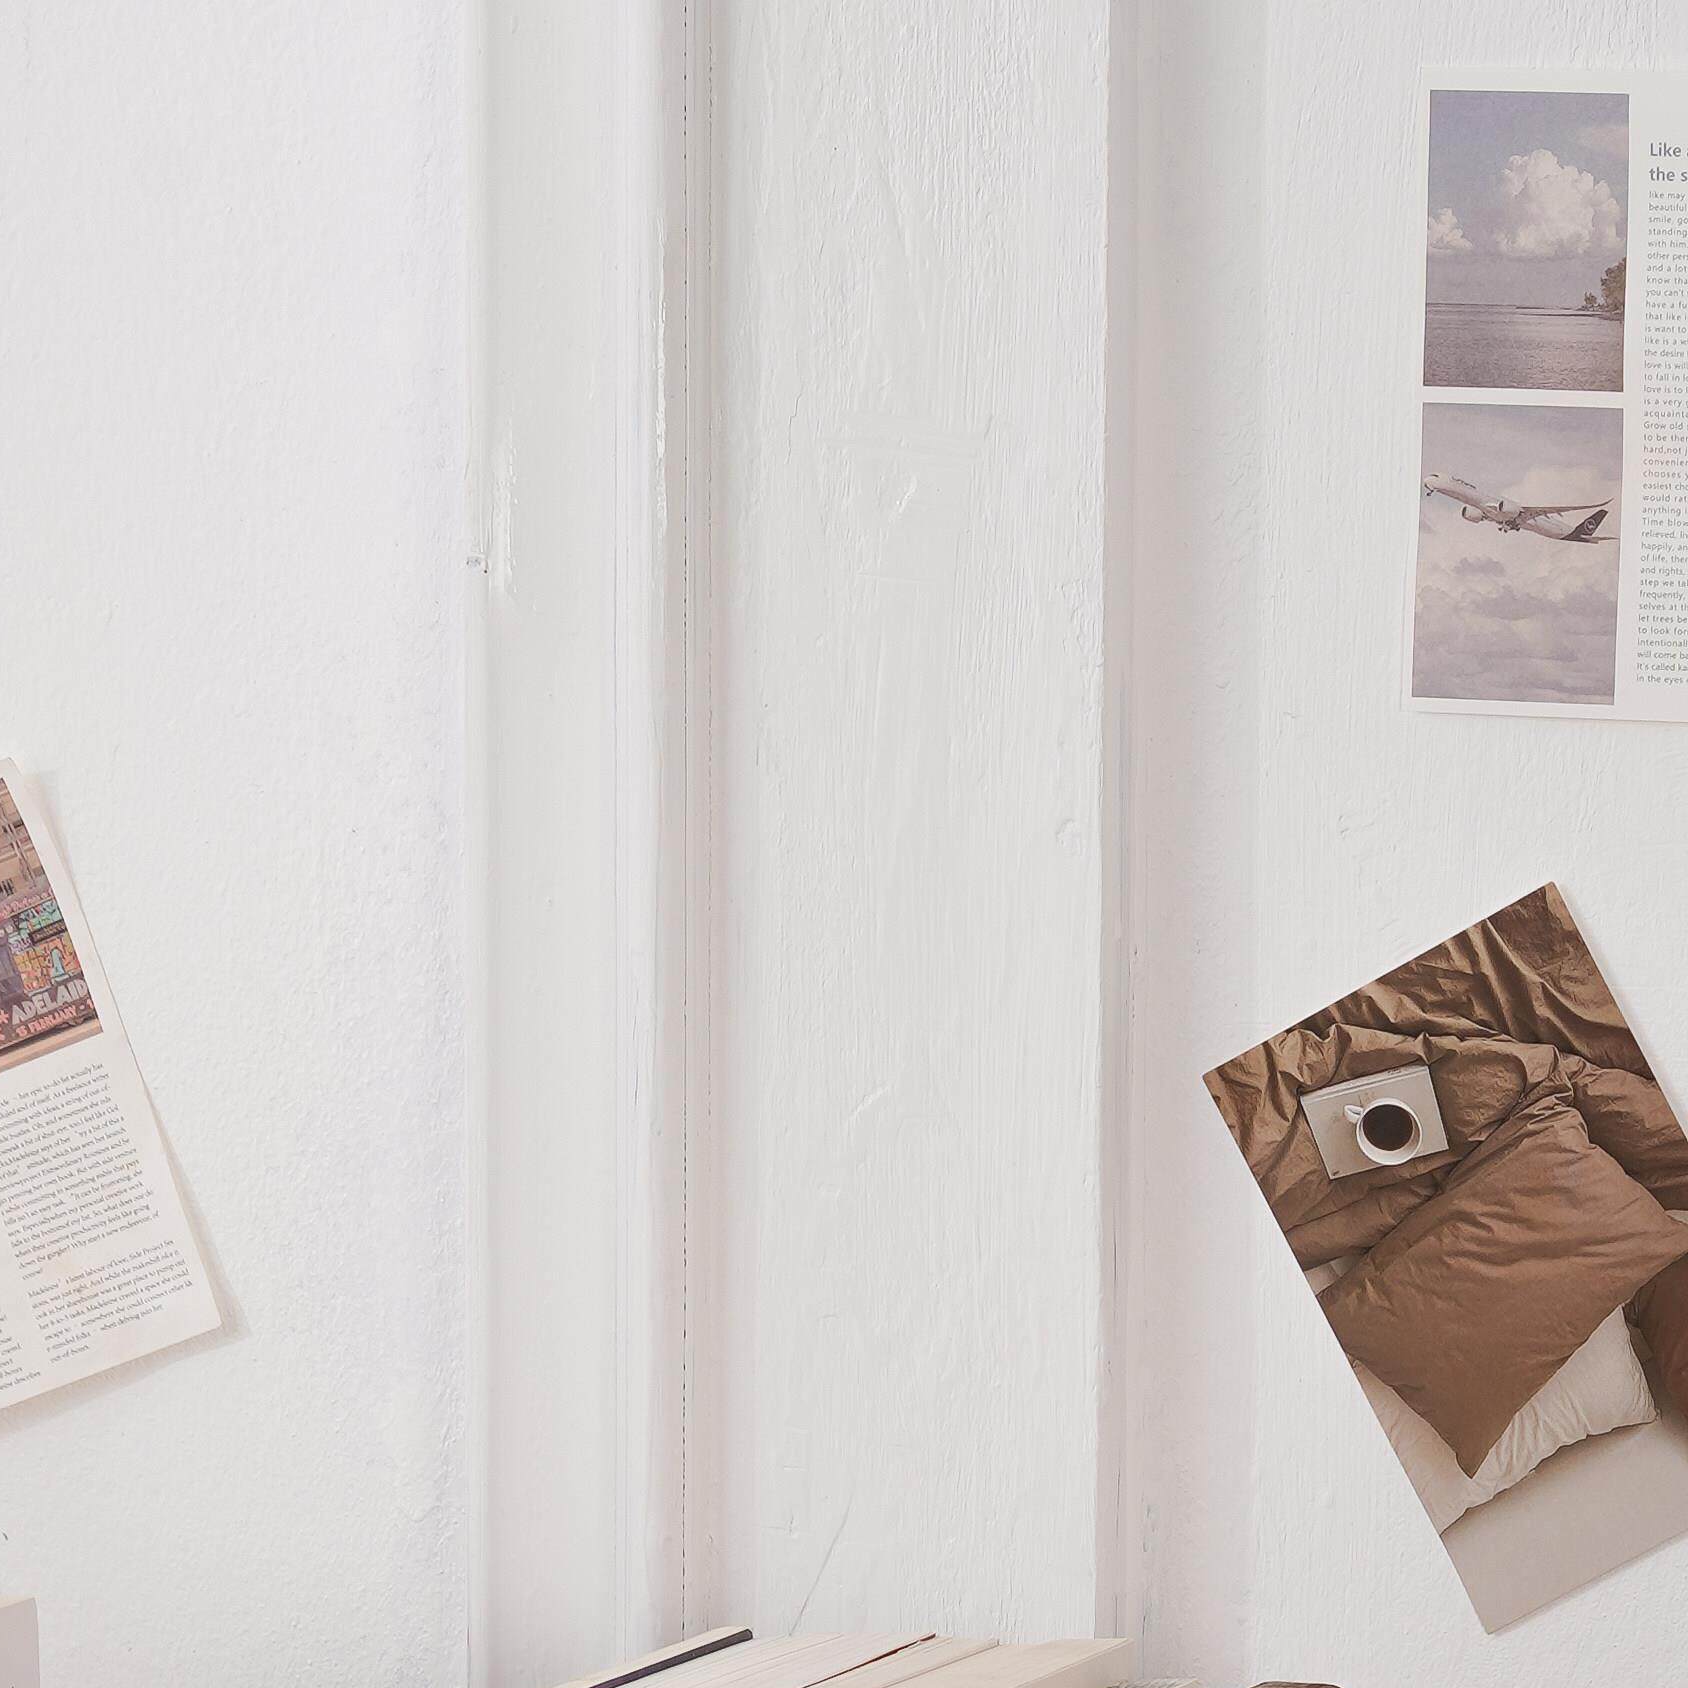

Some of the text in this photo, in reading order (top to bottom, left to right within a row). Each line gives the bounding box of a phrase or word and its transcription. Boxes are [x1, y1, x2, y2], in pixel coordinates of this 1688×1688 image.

[1649, 142, 1681, 157] Like
[1649, 168, 1675, 182] the
[1649, 191, 1685, 203] like may
[1648, 203, 1687, 212] beautiful
[1648, 227, 1688, 238] standing
[1648, 240, 1666, 248] with
[1648, 252, 1668, 260] other
[1647, 264, 1663, 272] and
[1647, 276, 1670, 284] know
[1645, 289, 1662, 297] you
[1645, 301, 1665, 309] have
[1645, 313, 1662, 321] that
[1645, 337, 1659, 345] like
[1645, 348, 1684, 357] the desire
[1644, 361, 1661, 369] love
[1656, 373, 1669, 381] fall
[1644, 385, 1661, 393] love
[1663, 398, 1682, 407] very
[1643, 470, 1681, 478] chooses
[1643, 482, 1672, 490] easiest
[1643, 494, 1669, 502] would
[1642, 507, 1681, 516] anything
[1642, 518, 1663, 526] Time
[1650, 626, 1669, 634] look
